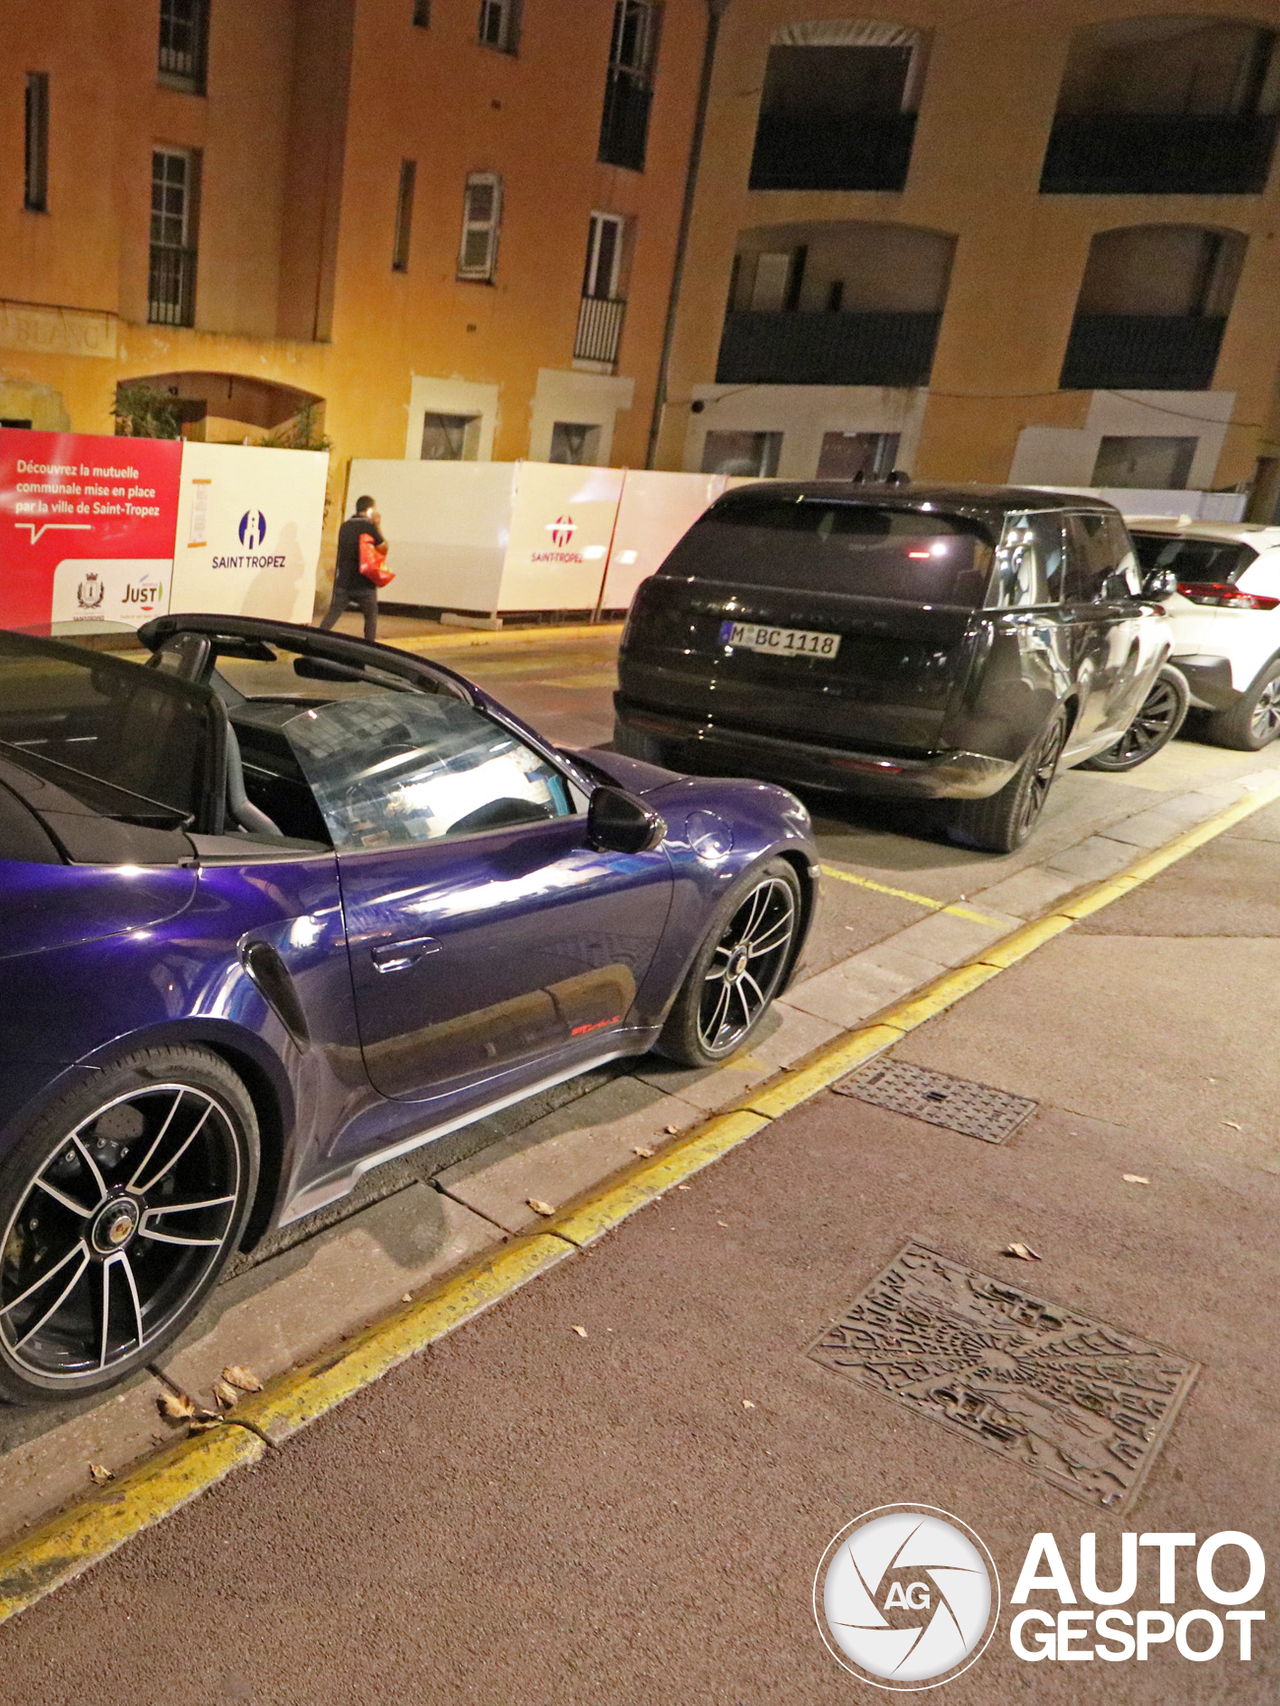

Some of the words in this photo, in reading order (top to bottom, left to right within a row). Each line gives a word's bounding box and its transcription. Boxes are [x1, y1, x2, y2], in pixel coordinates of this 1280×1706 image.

[17, 460, 78, 476] Découvrez
[80, 463, 90, 476] la
[93, 465, 139, 479] mutuelle
[16, 482, 81, 495] communale
[84, 483, 110, 496] mise
[112, 486, 125, 497] en
[128, 485, 156, 500] place
[15, 502, 35, 515] par
[38, 500, 49, 513] la
[51, 500, 74, 513] ville
[77, 501, 90, 514] de
[93, 502, 160, 518] Saint-Tropez
[121, 583, 157, 604] JUST
[730, 626, 745, 643] M
[754, 629, 781, 648] BC
[783, 633, 835, 655] 1118
